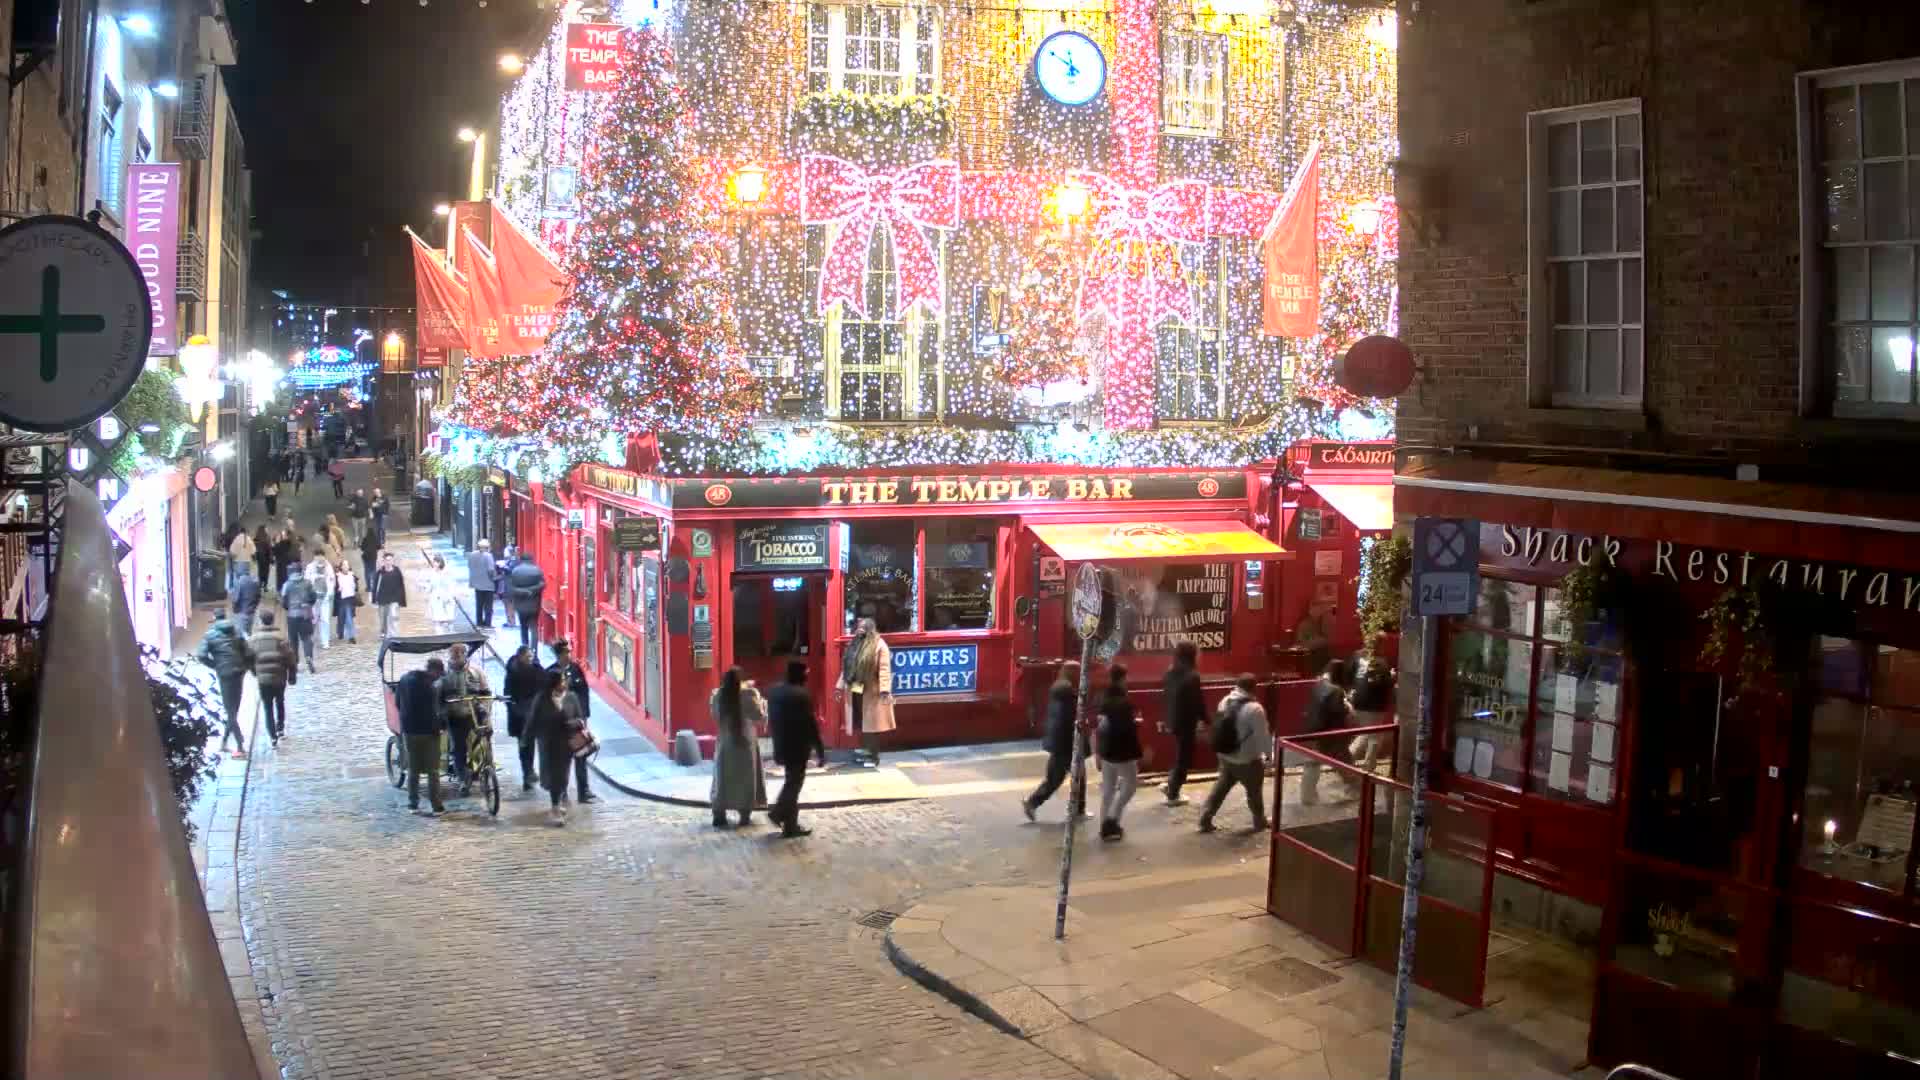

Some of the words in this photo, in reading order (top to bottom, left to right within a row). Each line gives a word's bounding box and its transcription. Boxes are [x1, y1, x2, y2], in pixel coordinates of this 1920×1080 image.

[584, 29, 619, 46] THE
[568, 47, 625, 65] TEMPL
[137, 171, 170, 233] NINE
[522, 304, 545, 313] THE
[502, 313, 556, 326] TEMPL
[824, 483, 899, 504] THE
[911, 480, 1050, 503] TEMPLE
[1067, 478, 1133, 500] BAR
[1201, 482, 1214, 493] 48
[751, 540, 817, 562] TOBACCO
[1204, 563, 1227, 578] THE
[1176, 579, 1227, 593] EMPEROR
[1423, 584, 1443, 602] 24
[1212, 593, 1226, 608] OF
[1184, 608, 1225, 629] LIQUORS
[890, 648, 969, 667] OWER'S
